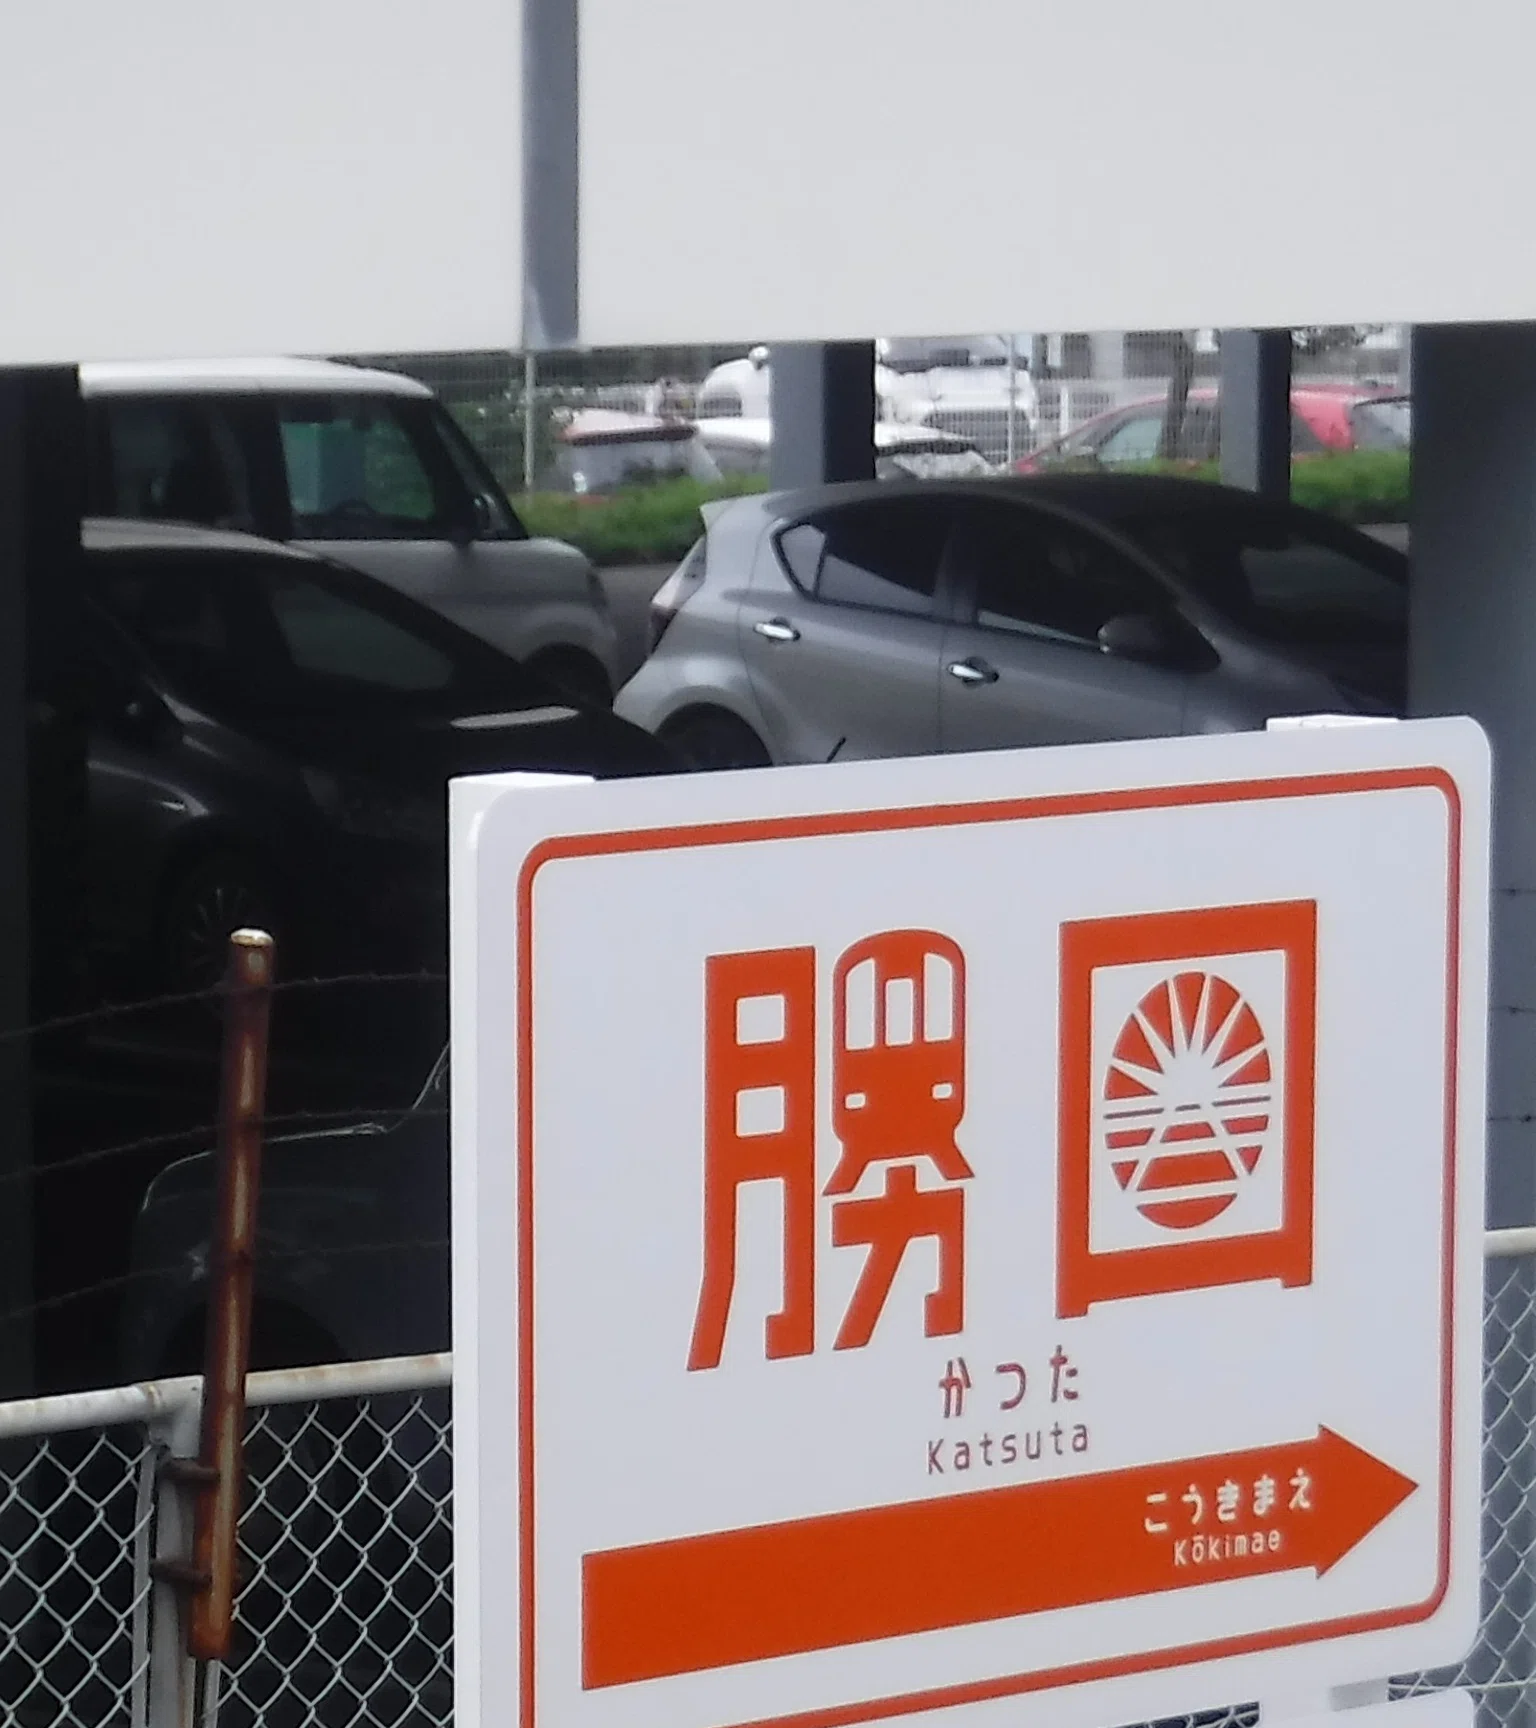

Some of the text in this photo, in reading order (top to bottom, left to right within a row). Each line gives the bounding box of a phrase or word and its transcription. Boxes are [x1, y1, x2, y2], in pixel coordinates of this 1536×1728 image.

[687, 899, 1318, 1371] 勝田
[939, 1345, 1079, 1418] かつた
[926, 1422, 1090, 1475] Katsuta
[1144, 1467, 1313, 1533] こうきまえ
[1173, 1528, 1282, 1567] Kōkimae
